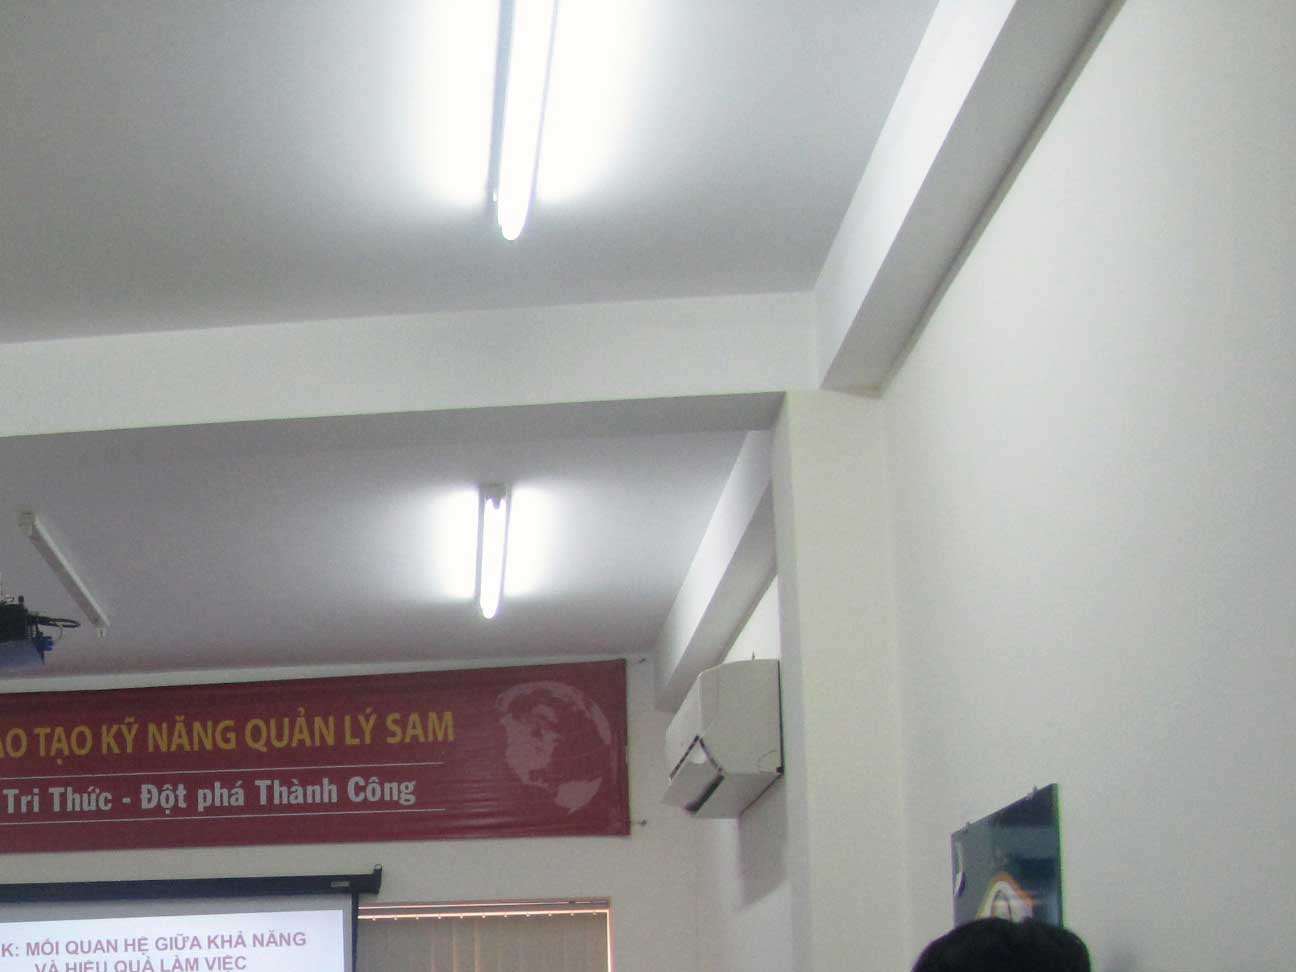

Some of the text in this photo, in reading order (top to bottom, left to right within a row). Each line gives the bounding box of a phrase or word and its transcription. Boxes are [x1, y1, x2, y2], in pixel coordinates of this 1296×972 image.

[34, 725, 93, 765] TẠO
[102, 716, 139, 754] KỸ
[148, 715, 237, 753] NĂNG
[245, 707, 336, 752] QUẢN
[344, 708, 377, 745] LÝ
[386, 711, 455, 744] SAM
[3, 788, 40, 814] Tri
[49, 785, 113, 813] Thức
[140, 783, 188, 814] Đột
[197, 780, 245, 812] phá
[254, 777, 338, 806] Thành
[347, 776, 417, 806] Công
[65, 939, 118, 954] QUAN
[207, 930, 247, 949] KHẢ
[252, 930, 307, 948] NĂNG
